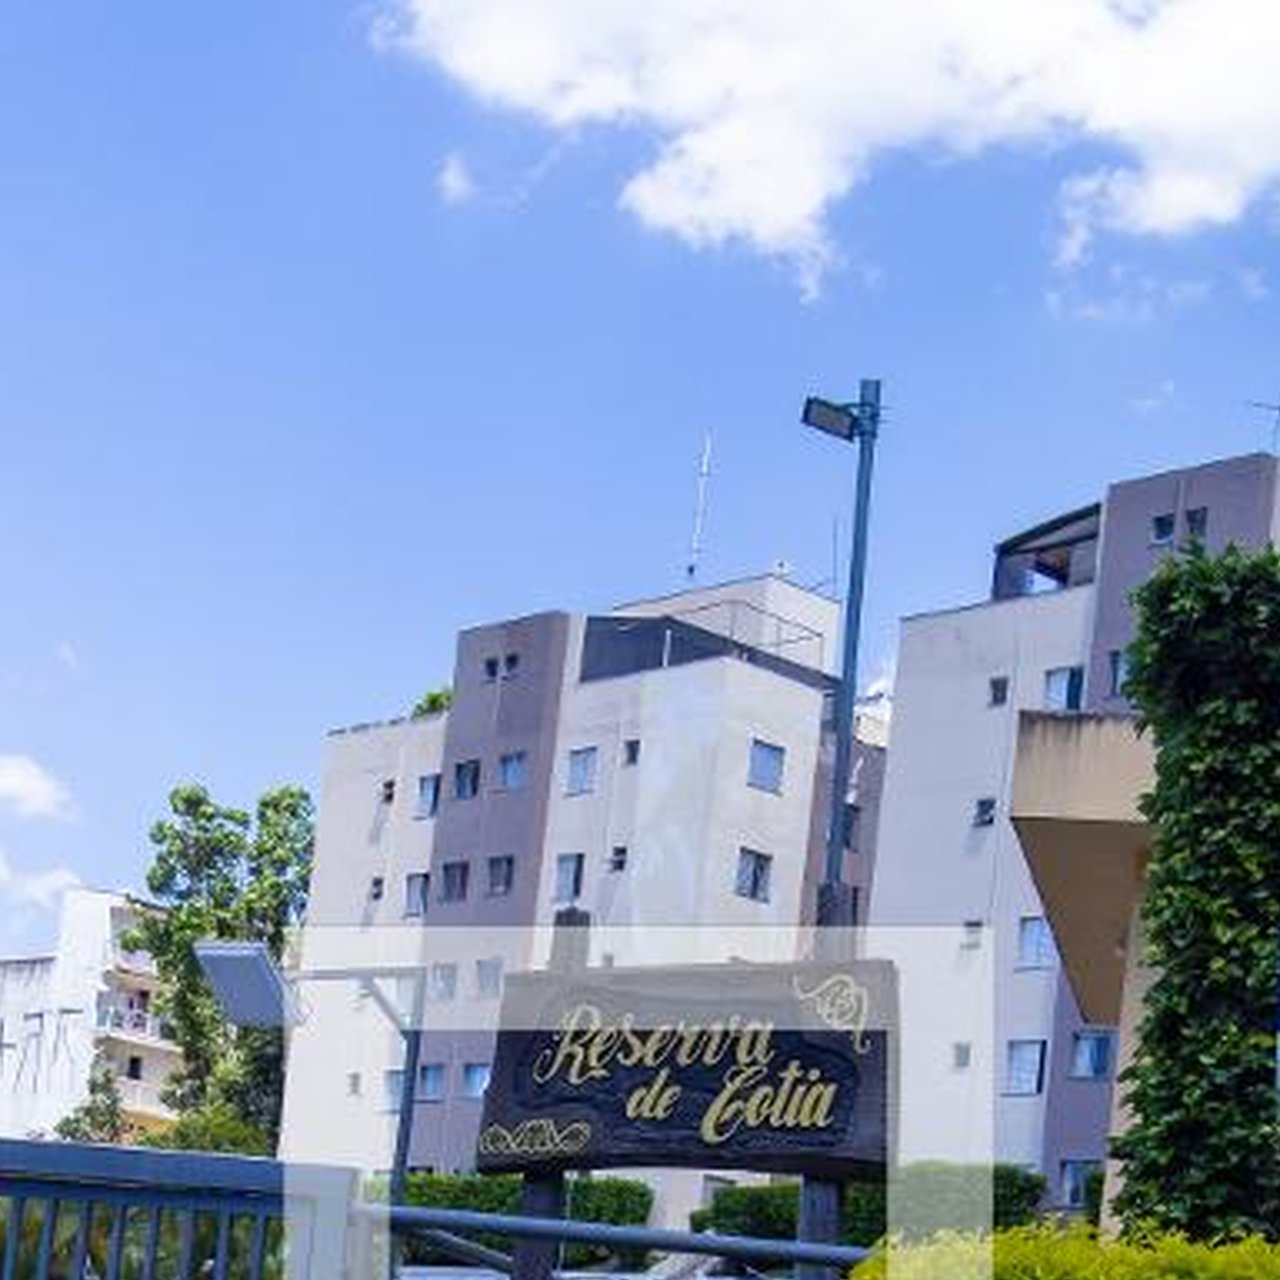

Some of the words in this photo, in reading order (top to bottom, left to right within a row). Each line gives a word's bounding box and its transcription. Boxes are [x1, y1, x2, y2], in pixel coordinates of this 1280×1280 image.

[532, 1004, 775, 1085] Reserva
[626, 1069, 681, 1121] de
[699, 1060, 841, 1145] Cotia
